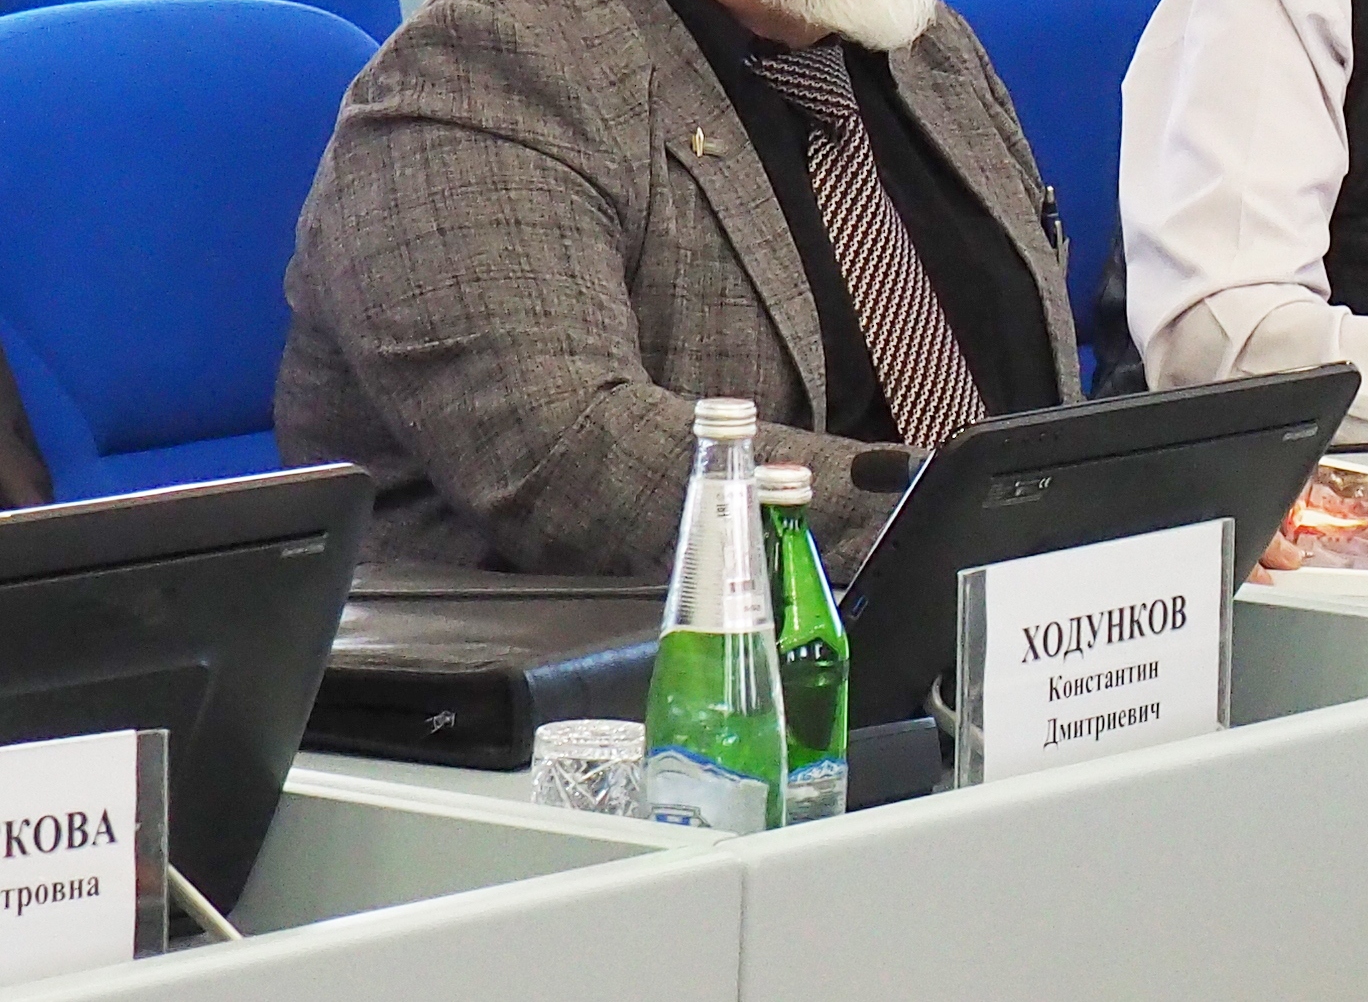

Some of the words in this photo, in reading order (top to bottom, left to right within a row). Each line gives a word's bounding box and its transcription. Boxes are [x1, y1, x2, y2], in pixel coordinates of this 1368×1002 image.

[1021, 595, 1188, 664] ХОДУНКОВ
[1048, 660, 1160, 702] Константин
[1043, 701, 1161, 751] Дмитриевич
